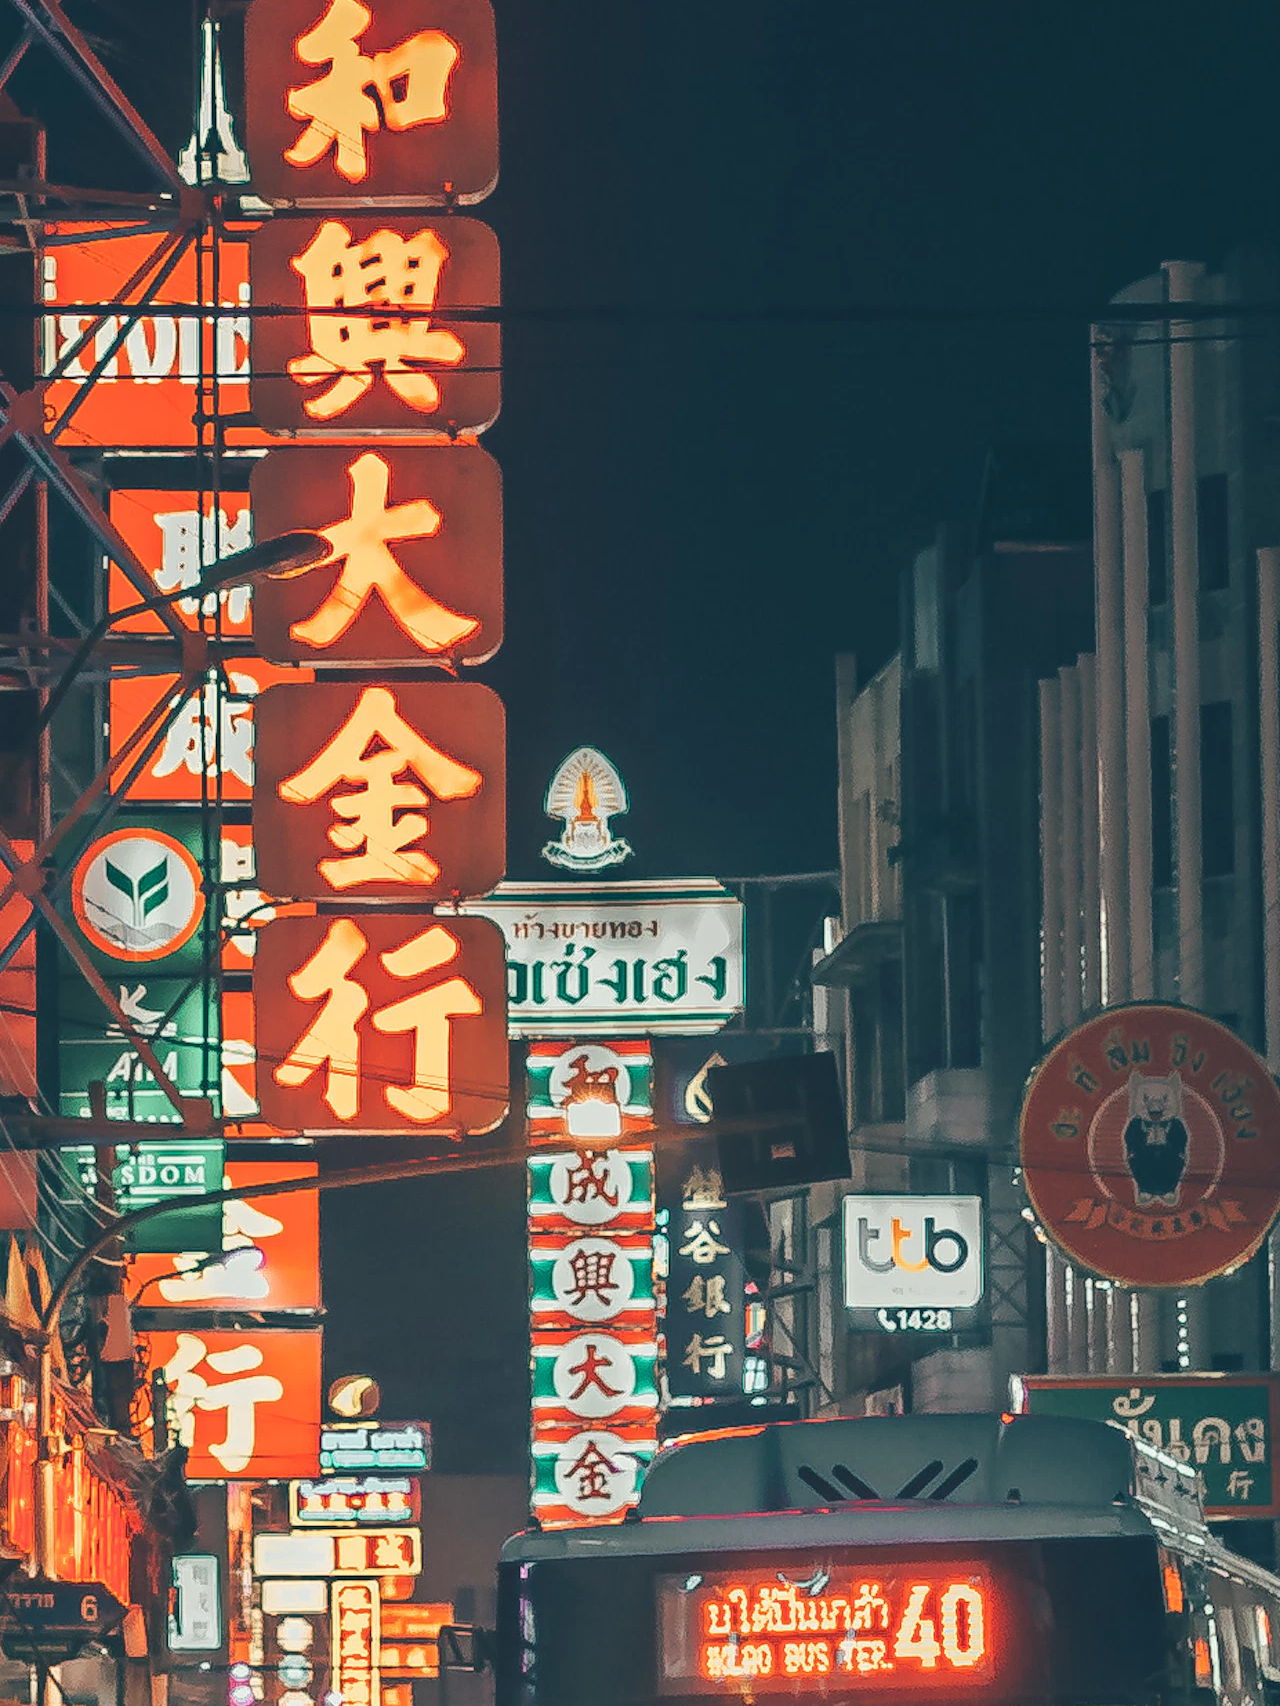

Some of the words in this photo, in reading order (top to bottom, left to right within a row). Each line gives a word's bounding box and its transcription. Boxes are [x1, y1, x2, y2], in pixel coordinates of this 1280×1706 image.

[513, 912, 660, 940] ห้างขายทอง
[857, 1216, 969, 1273] ttb
[896, 1309, 953, 1331] 1428
[81, 1595, 98, 1622] 6
[894, 1584, 985, 1668] 40
[783, 1642, 830, 1673] BUS
